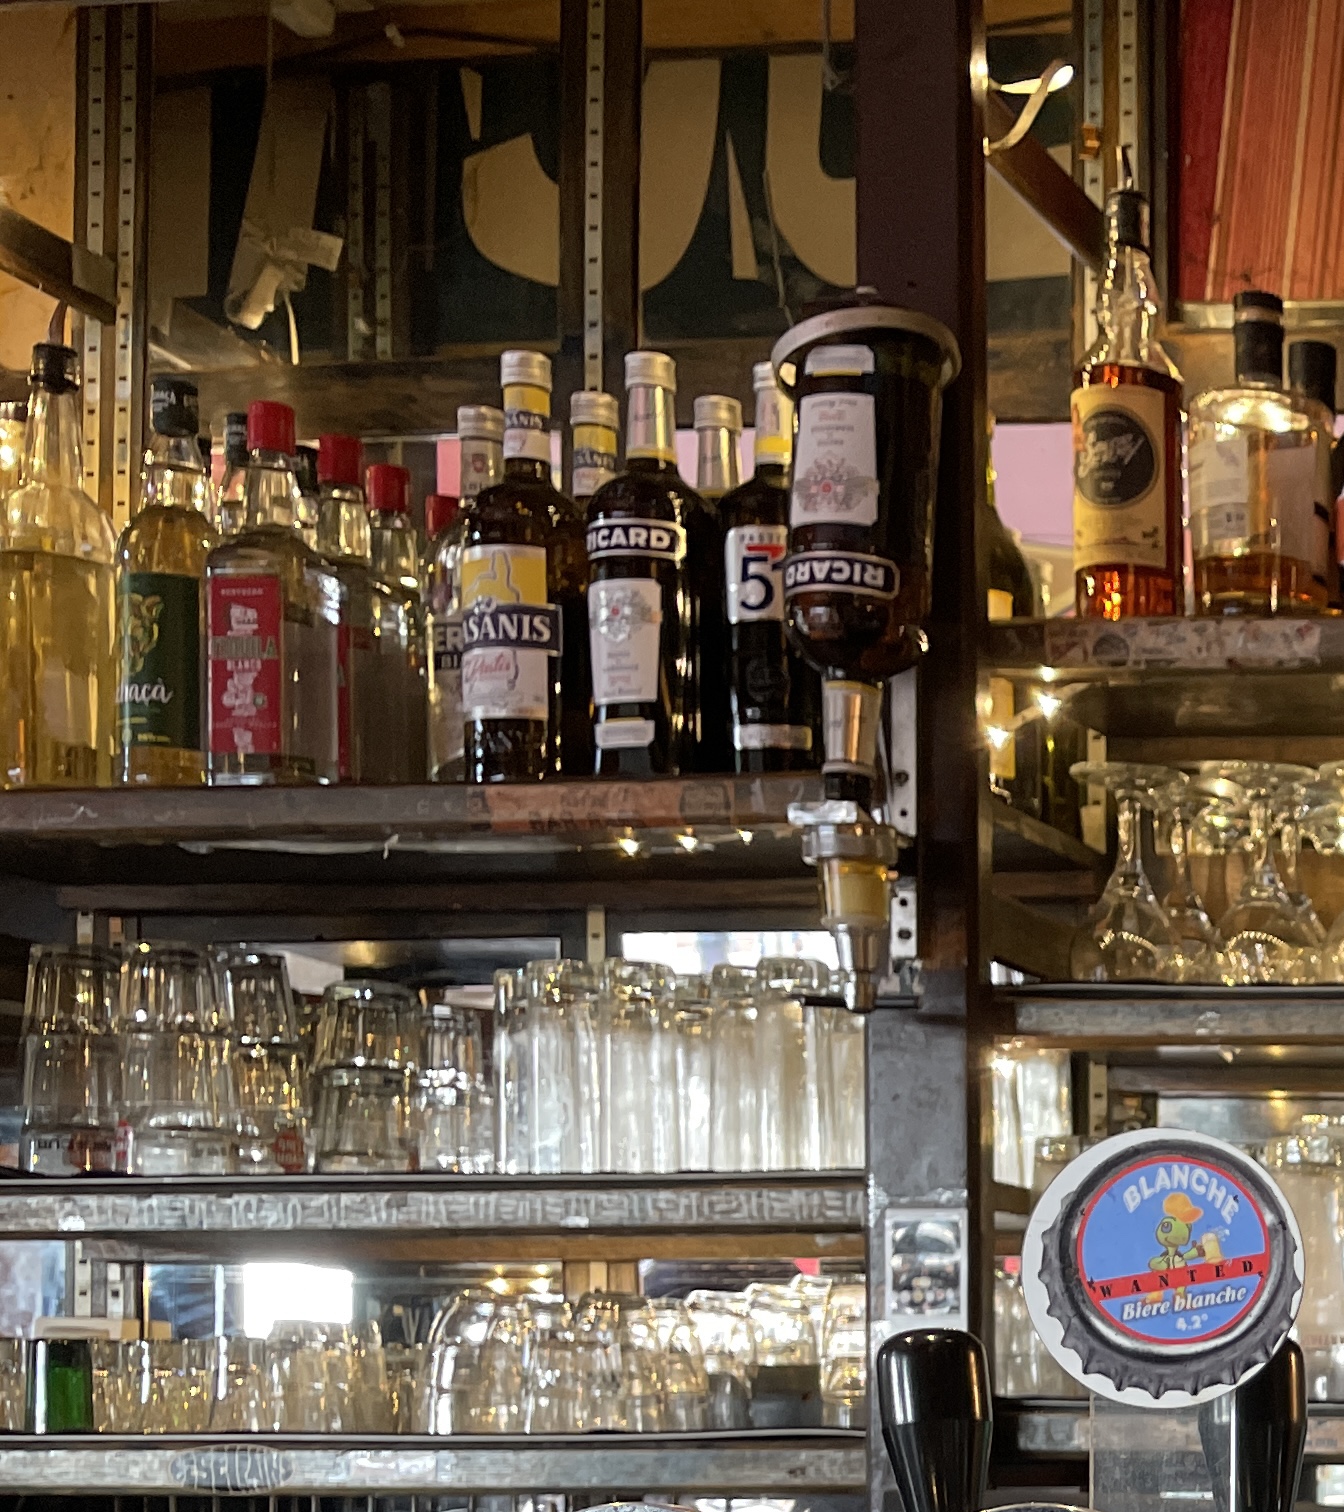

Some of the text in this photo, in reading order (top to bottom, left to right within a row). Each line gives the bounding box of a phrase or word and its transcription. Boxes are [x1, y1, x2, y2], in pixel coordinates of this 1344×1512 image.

[1122, 1164, 1239, 1225] BLANCHE
[1099, 1259, 1254, 1299] WANTED
[1122, 1284, 1248, 1322] Bière blanche
